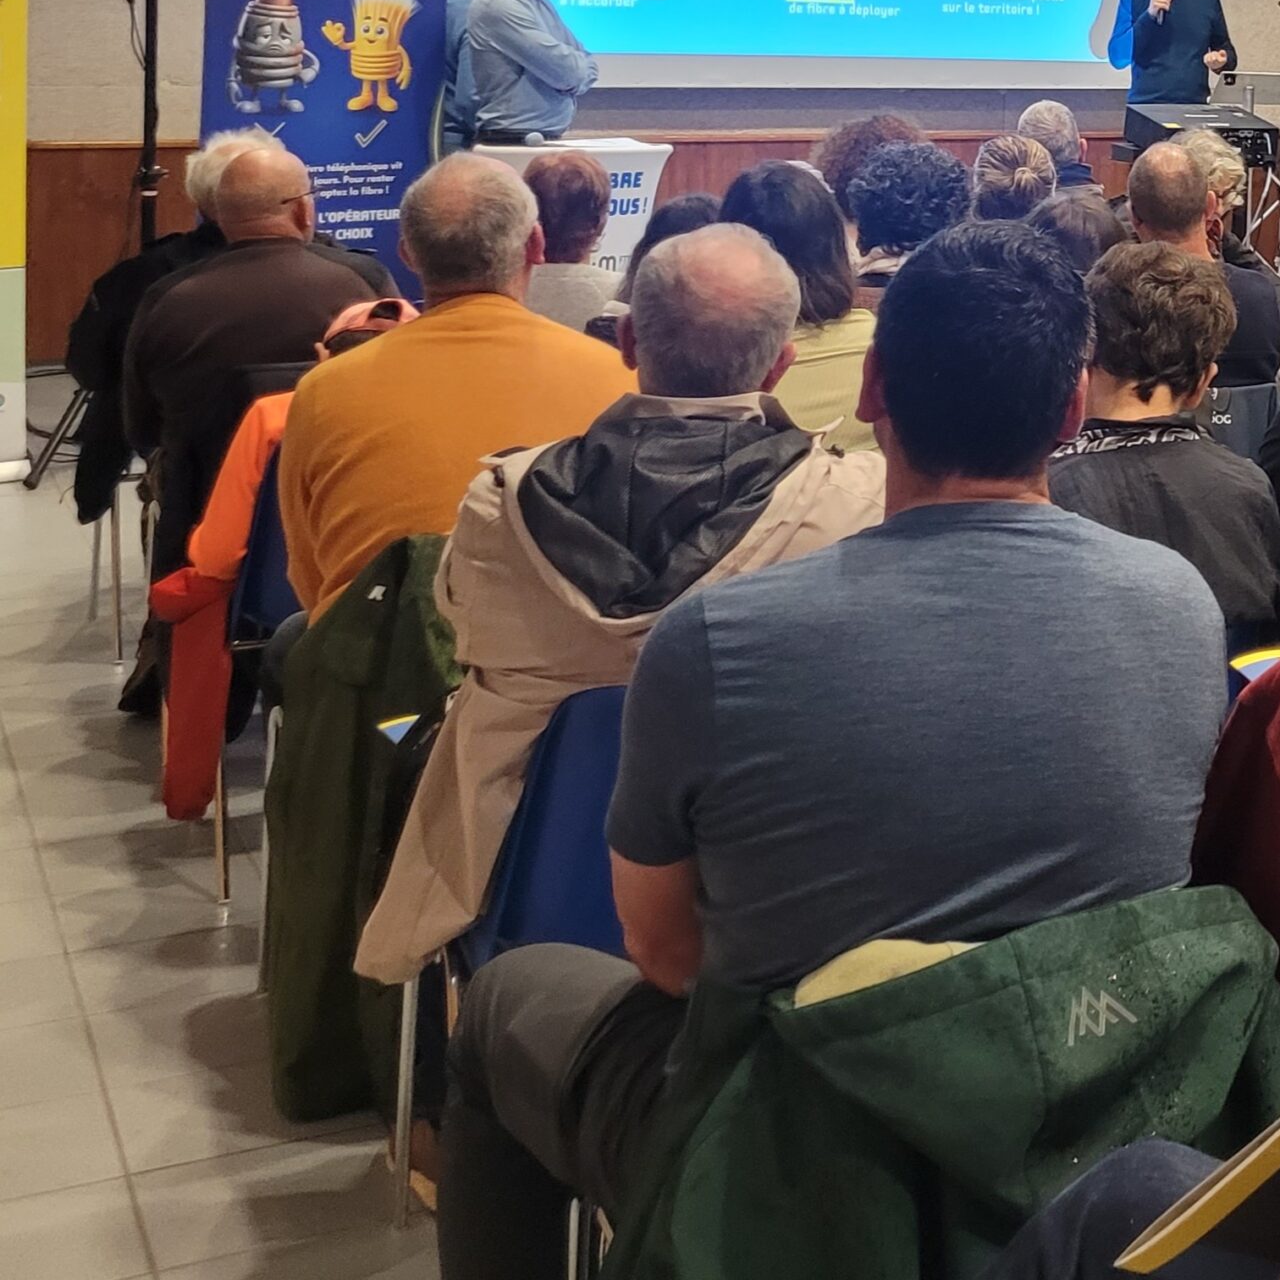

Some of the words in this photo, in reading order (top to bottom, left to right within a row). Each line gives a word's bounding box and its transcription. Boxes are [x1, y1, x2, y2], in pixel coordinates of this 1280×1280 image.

[789, 3, 802, 13] de
[807, 3, 835, 14] fibre
[849, 4, 900, 19] déployer
[943, 3, 961, 13] sur
[964, 2, 975, 14] le
[979, 3, 1033, 15] territoire
[326, 162, 388, 174] téléphonique
[343, 175, 364, 184] Pour
[610, 172, 644, 189] BRE
[349, 187, 359, 196] la
[361, 186, 383, 195] fibre
[335, 227, 373, 240] CHOIX
